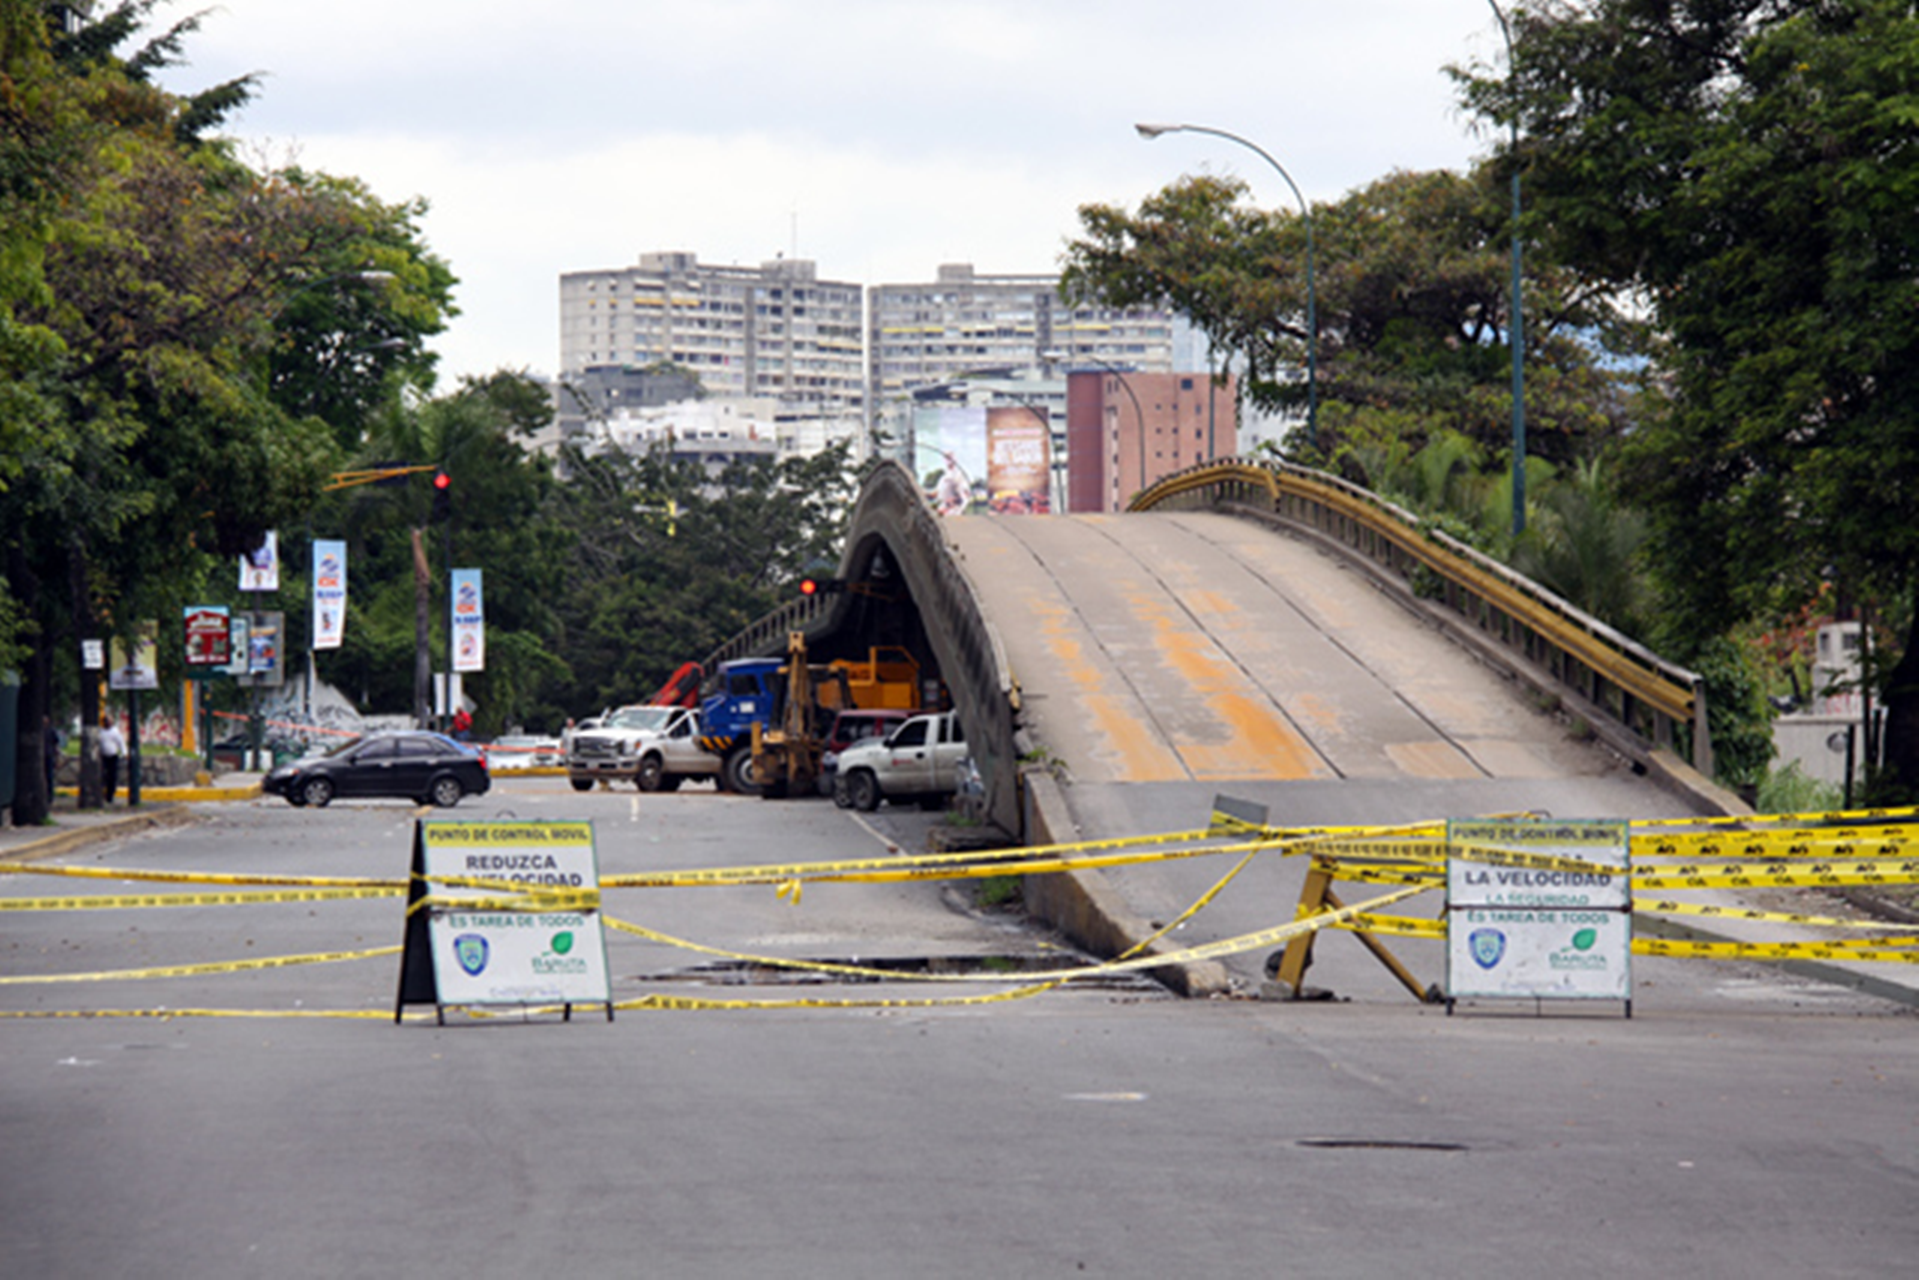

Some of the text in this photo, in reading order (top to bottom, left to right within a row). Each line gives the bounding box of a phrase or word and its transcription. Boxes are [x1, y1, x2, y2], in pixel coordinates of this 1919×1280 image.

[429, 828, 588, 841] PUNTO DE CONTROL MOVIL
[1453, 827, 1495, 839] PUNTO
[1500, 828, 1518, 840] DE
[1520, 827, 1577, 839] CONTROL
[466, 855, 557, 869] REDUZCA
[1465, 871, 1611, 887] LA VELOCIDAD
[1486, 893, 1590, 906] LA SEGURIDAD
[450, 915, 584, 928] ES TAREA DE TODOS
[1467, 911, 1610, 924] ES TAREA DE TODOS
